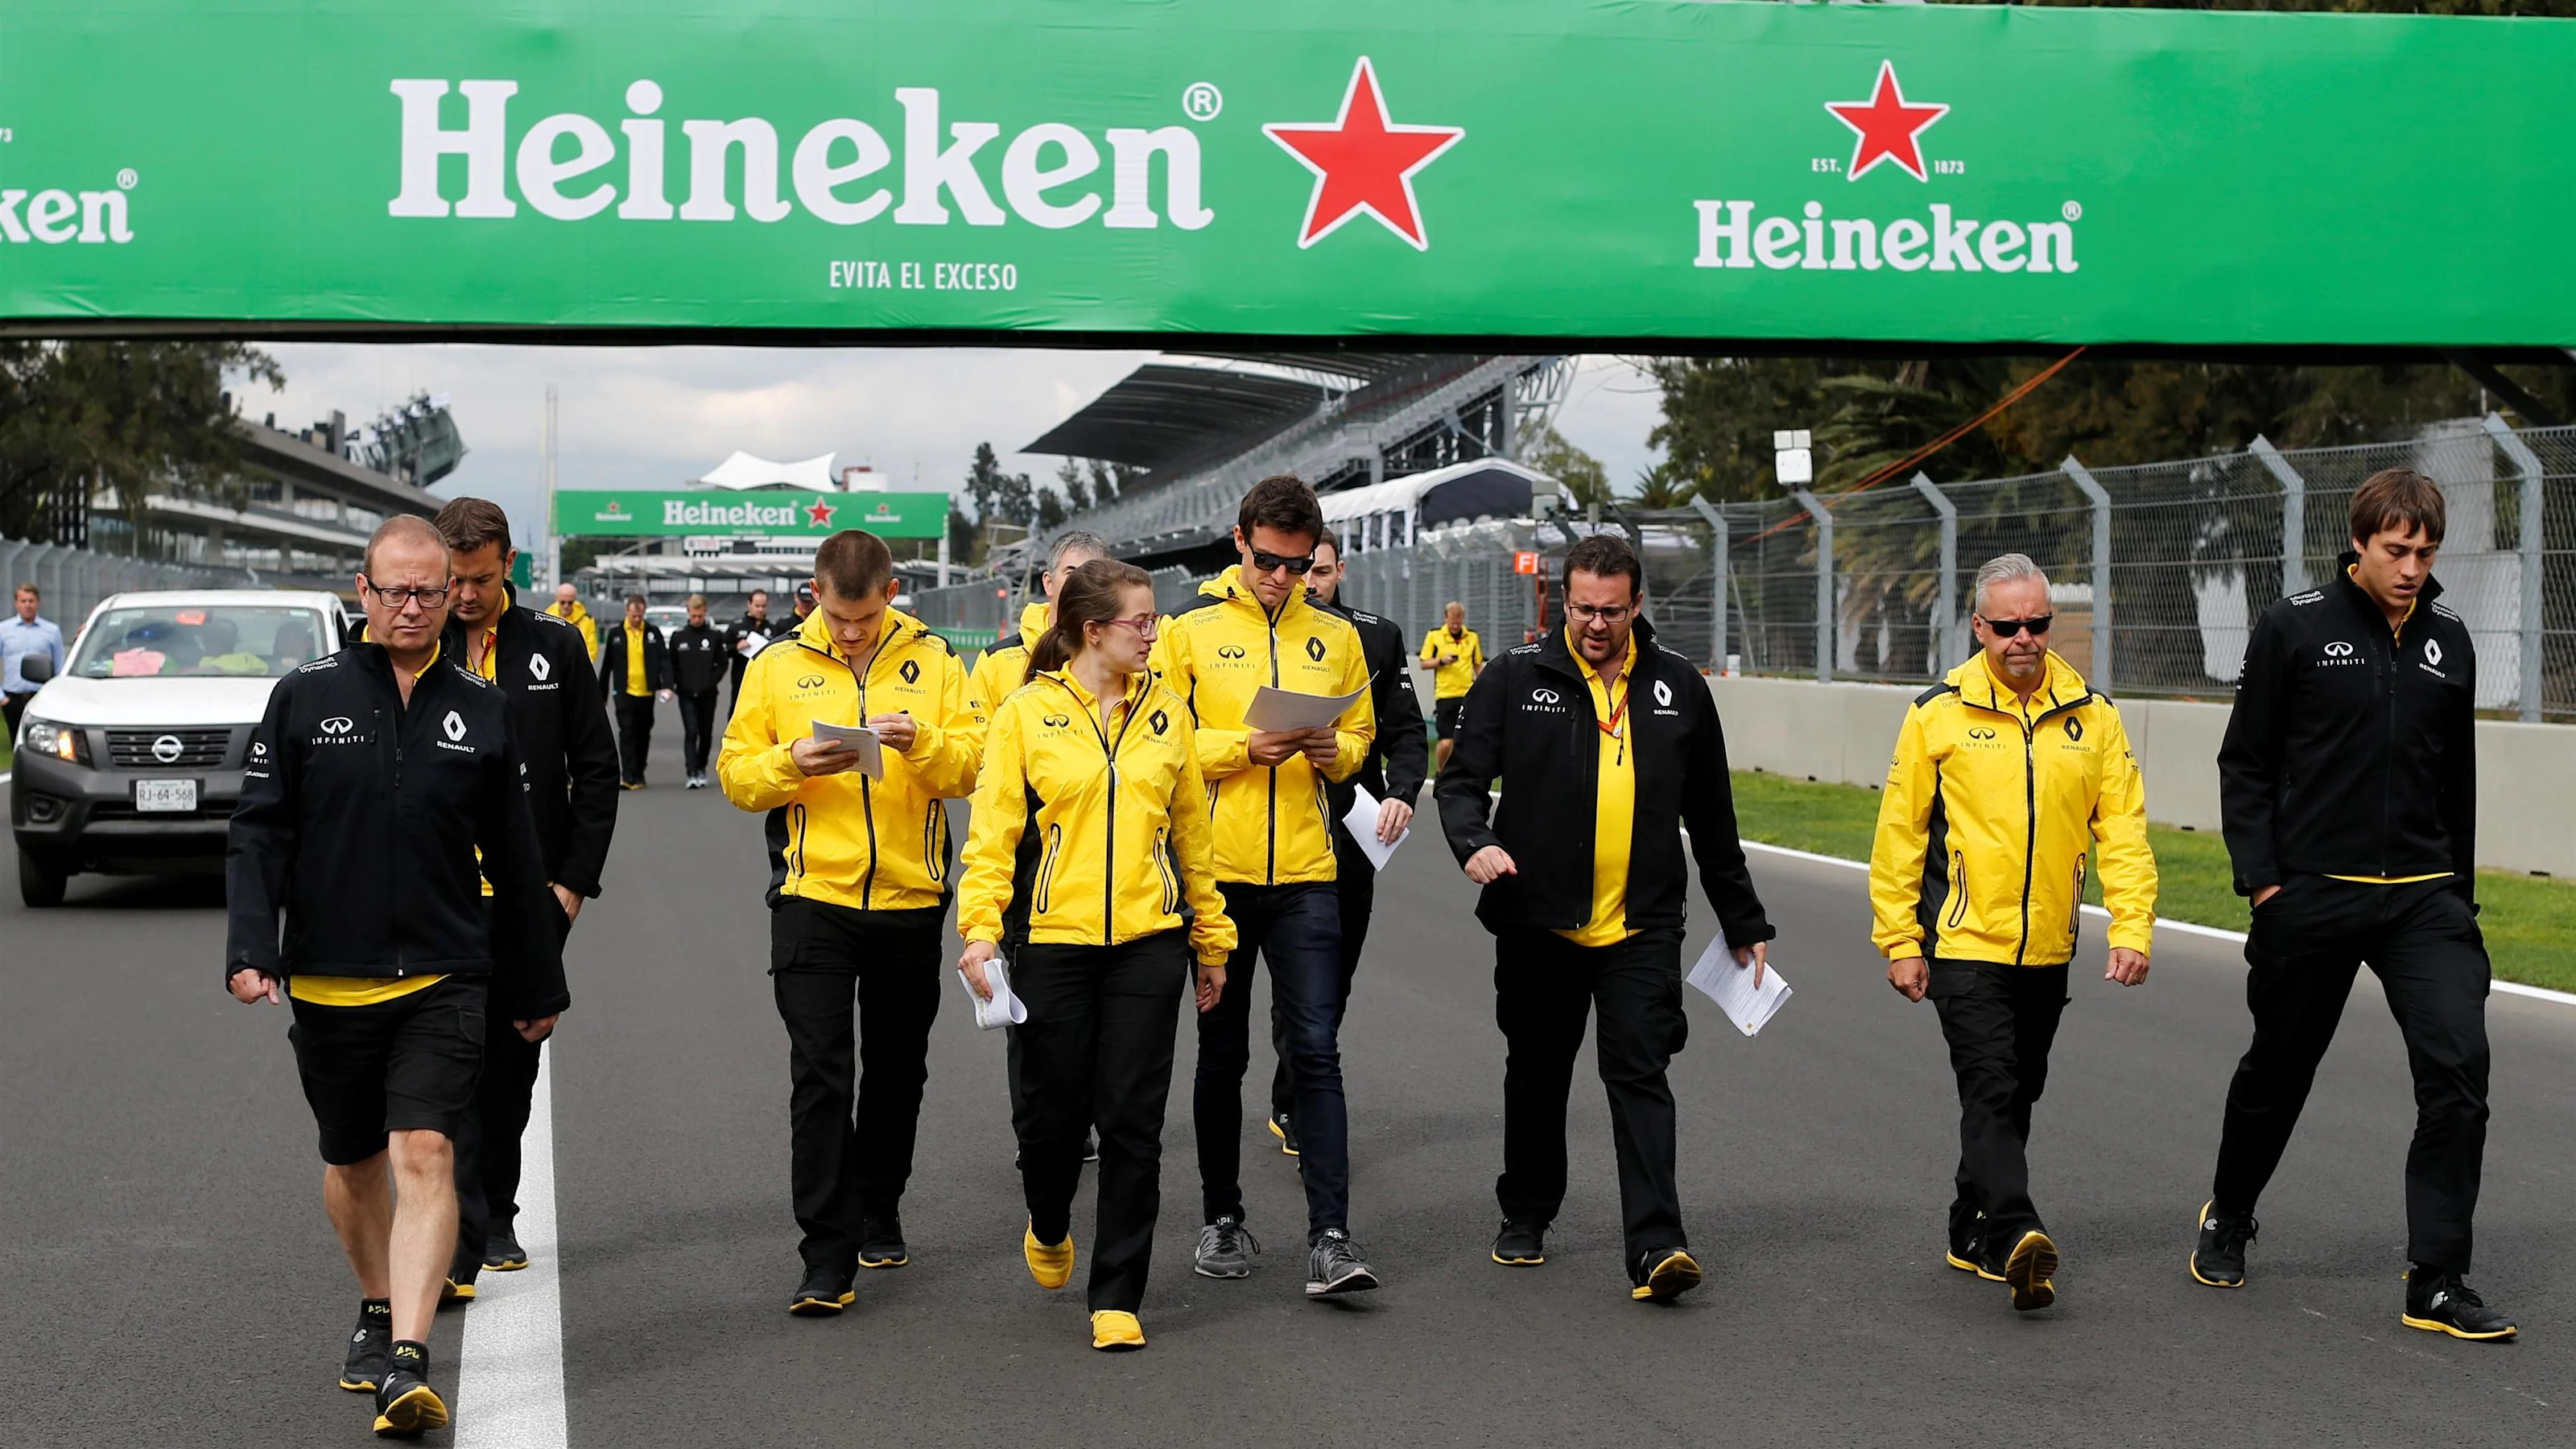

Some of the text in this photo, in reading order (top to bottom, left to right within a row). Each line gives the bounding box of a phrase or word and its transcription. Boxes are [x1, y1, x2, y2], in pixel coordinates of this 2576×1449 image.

[1812, 158, 1965, 174] EST. 1873
[830, 260, 1018, 291] EVITA EL EXCESO
[2289, 590, 2322, 601] Microsoft
[2292, 595, 2325, 606] Dynamics
[1191, 608, 1220, 619] Microsoft
[1353, 613, 1378, 625] Dynamics
[1354, 610, 1379, 621] Microsoft
[535, 614, 567, 627] Dynamics
[1195, 614, 1224, 626] Dynamics
[1314, 616, 1342, 631] Dynamics
[299, 662, 339, 674] Dynamics
[2316, 658, 2365, 667] INFINITI
[2419, 663, 2446, 679] RENAULT
[527, 683, 559, 691] RENAULT
[894, 686, 927, 696] RENAULT
[789, 689, 836, 700] INFINITI
[1521, 704, 1566, 713] INFINITI
[312, 735, 365, 745] INFINITI
[1960, 741, 2007, 749] INFINITI
[436, 740, 476, 754] RENAULT
[2061, 745, 2091, 753] RENAULT
[138, 789, 194, 802] RJ-64-568
